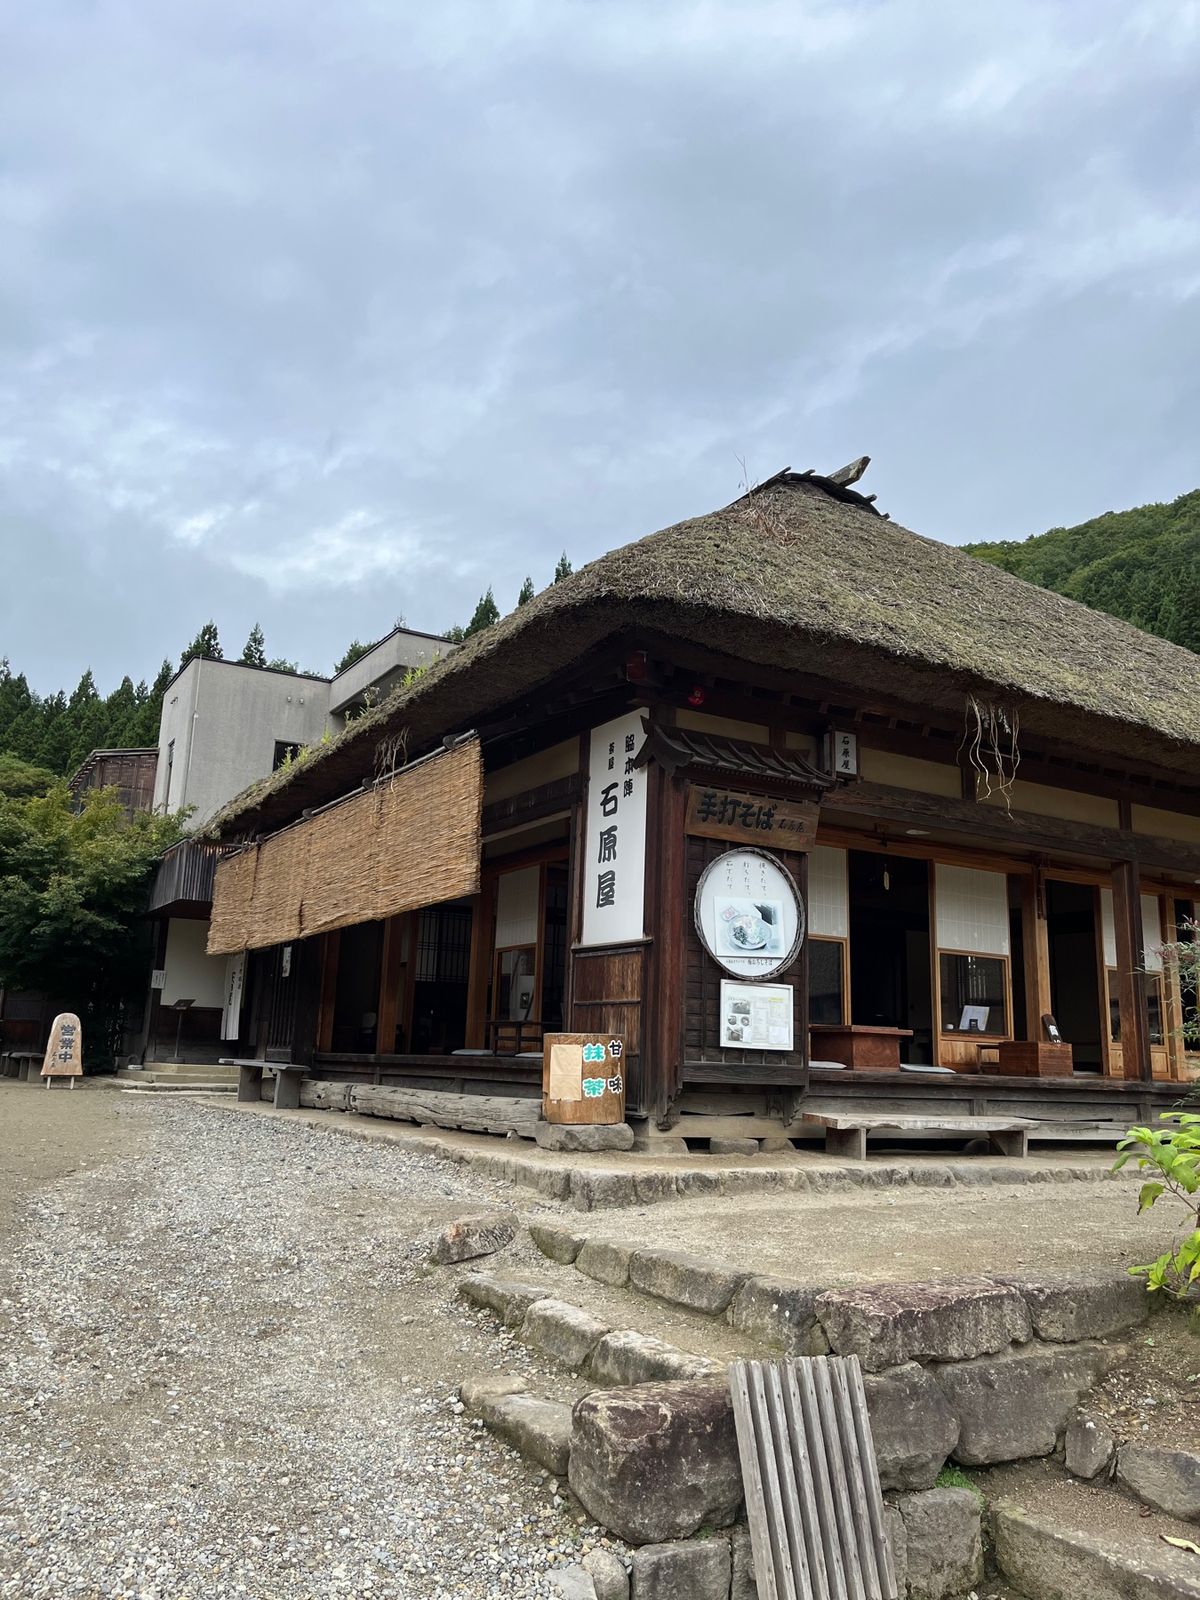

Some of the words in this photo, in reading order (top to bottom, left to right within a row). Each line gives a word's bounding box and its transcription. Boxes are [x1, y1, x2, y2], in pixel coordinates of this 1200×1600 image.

[608, 742, 615, 771] 茶屋
[841, 736, 850, 770] 石原屋
[696, 790, 778, 831] 手打そば
[596, 781, 620, 910] 石原屋
[58, 1024, 76, 1063] 営業中
[582, 1043, 606, 1098] 抹茶
[607, 1039, 623, 1095] 甘味
